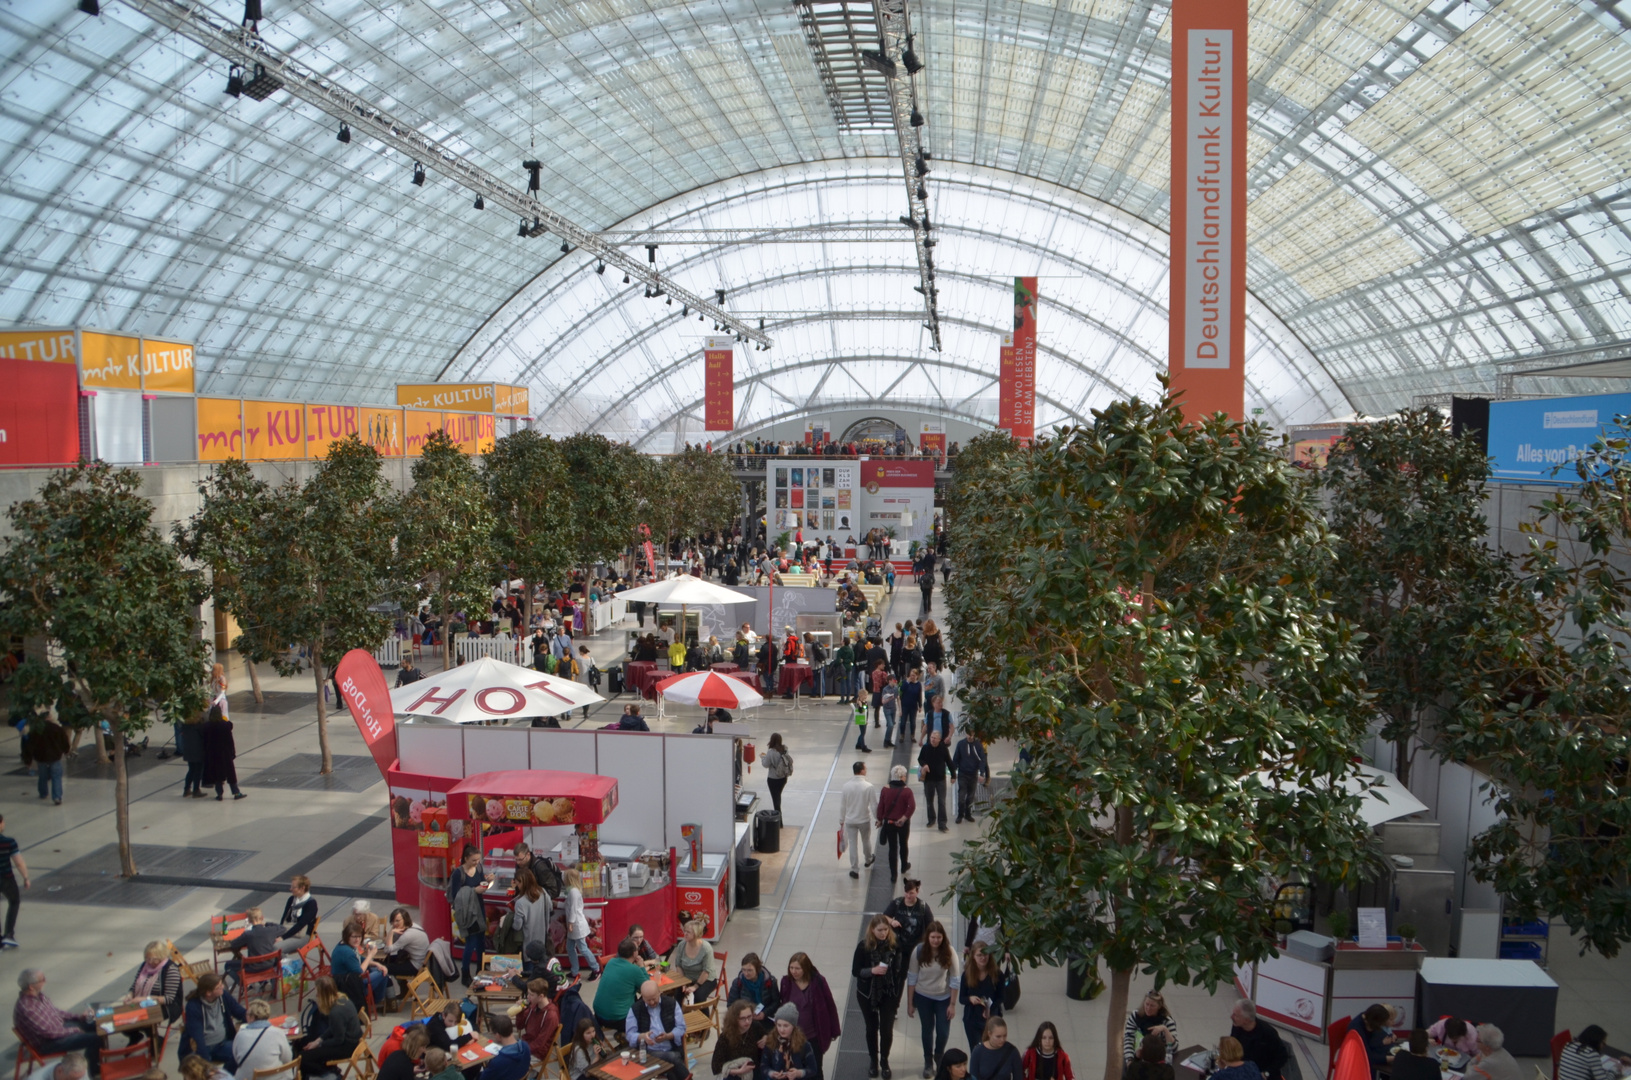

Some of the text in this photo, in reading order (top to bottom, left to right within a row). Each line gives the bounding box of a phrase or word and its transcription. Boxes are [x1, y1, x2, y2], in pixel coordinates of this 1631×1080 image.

[1196, 37, 1221, 359] Deutschlandfunk Kultur
[127, 348, 194, 377] KULTUR
[1024, 336, 1034, 424] SIE AM LIEBSTEN?
[433, 386, 493, 407] KULTUR
[1014, 348, 1024, 424] UND WO LESEN
[266, 406, 357, 447] KULTUR
[443, 414, 494, 444] KULTUR
[1516, 444, 1543, 462] Alles
[1544, 448, 1566, 464] von
[404, 680, 576, 716] HOT
